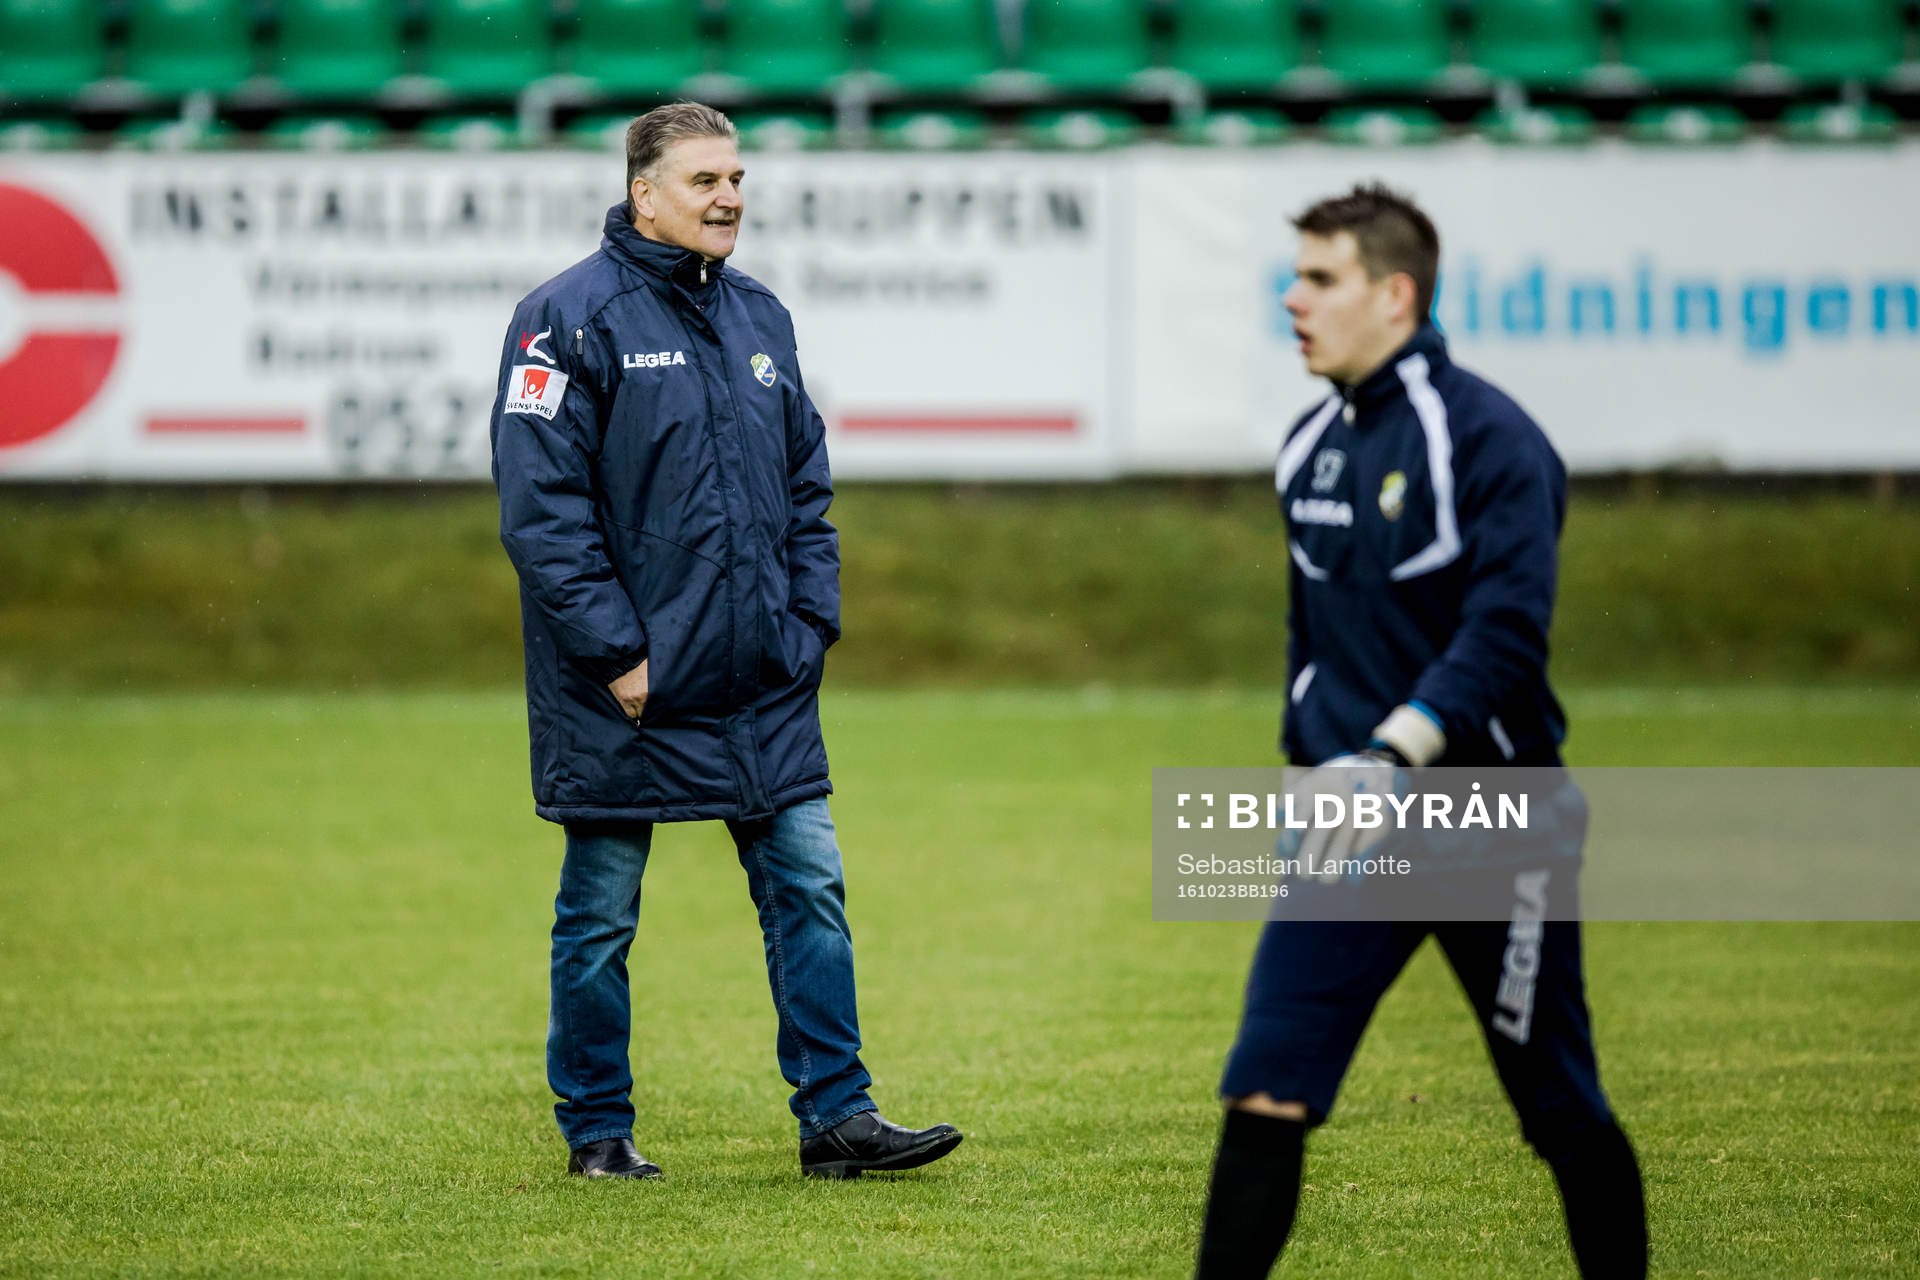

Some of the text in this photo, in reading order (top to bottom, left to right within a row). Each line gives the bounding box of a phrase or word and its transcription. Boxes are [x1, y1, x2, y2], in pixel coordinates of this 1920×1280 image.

[623, 351, 687, 369] LEGEA
[535, 404, 553, 417] SPEL
[1493, 869, 1550, 1045] LEGEA
